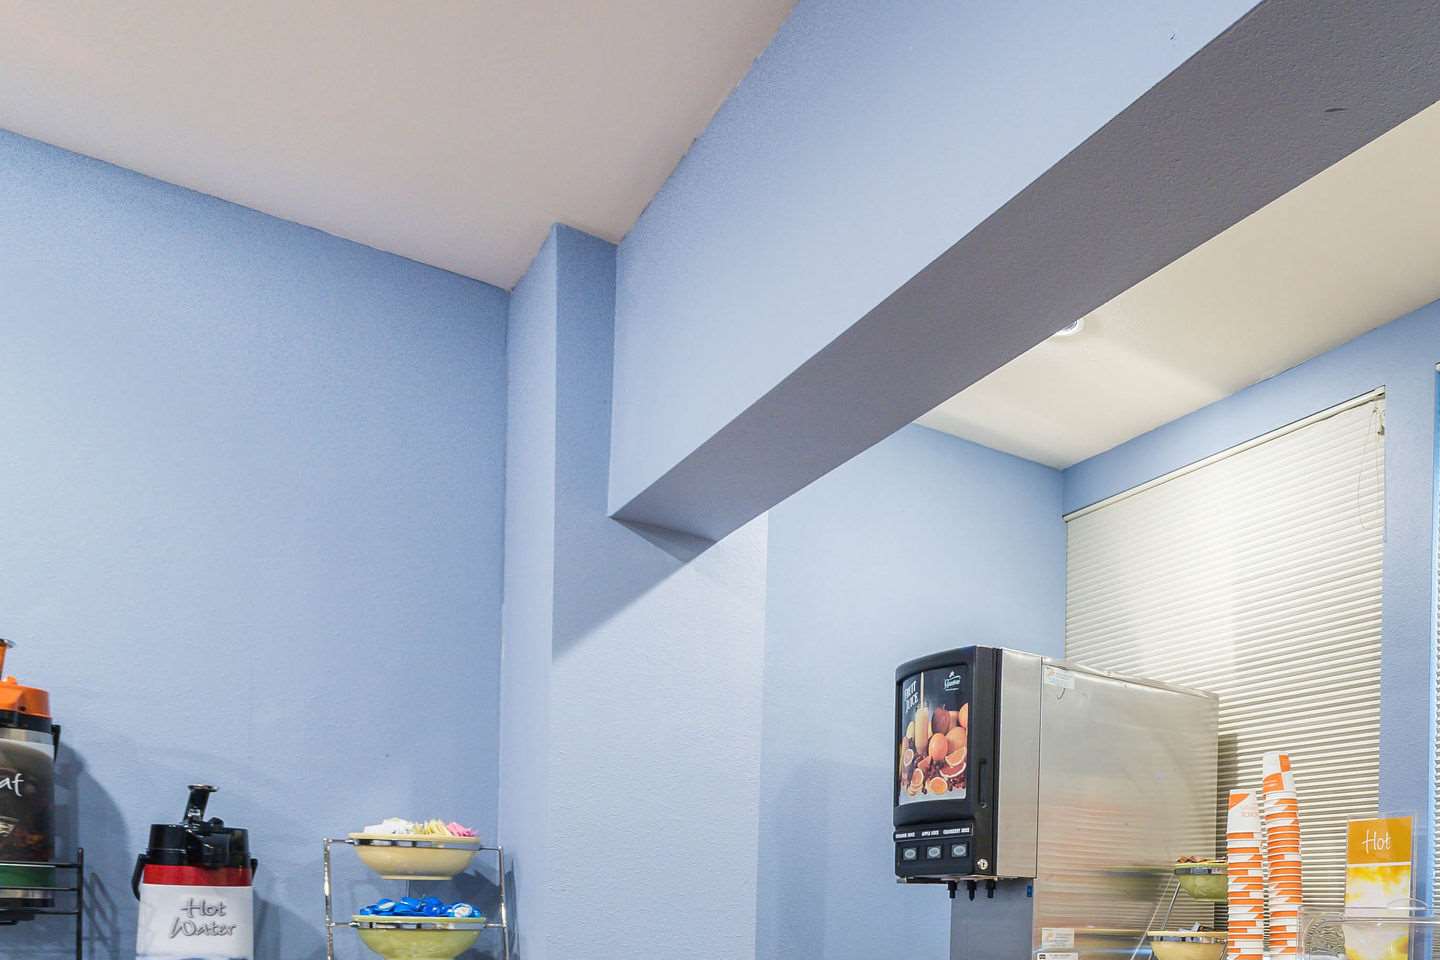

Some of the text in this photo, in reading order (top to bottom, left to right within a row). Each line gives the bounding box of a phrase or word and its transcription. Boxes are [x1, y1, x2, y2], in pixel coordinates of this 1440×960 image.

[1361, 829, 1392, 855] Hot
[180, 898, 227, 918] Hot
[169, 917, 237, 939] Water
